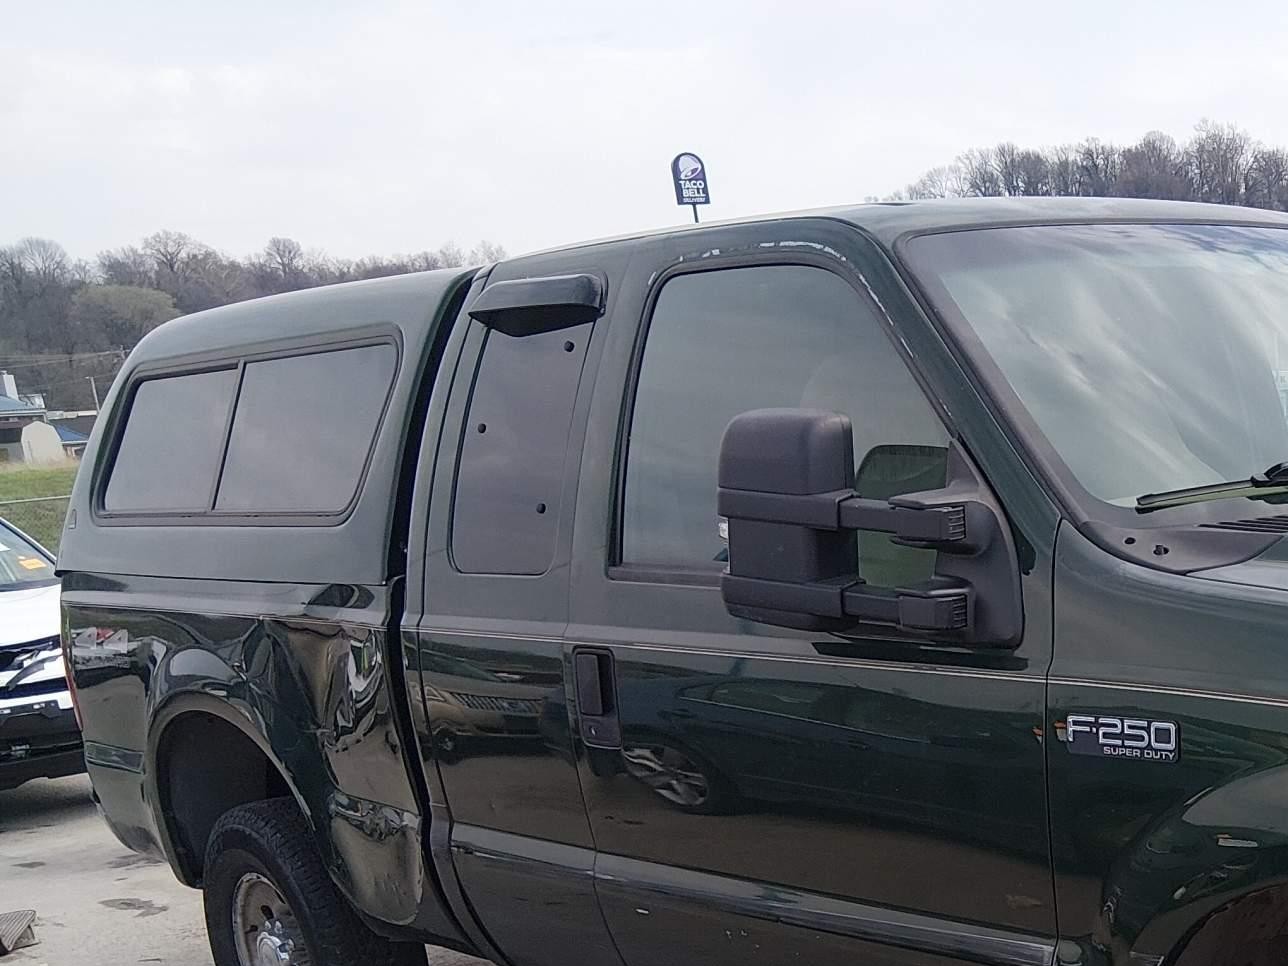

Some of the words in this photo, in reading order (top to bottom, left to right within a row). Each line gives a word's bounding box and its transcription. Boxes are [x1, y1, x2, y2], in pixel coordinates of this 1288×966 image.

[679, 180, 705, 189] TACO
[683, 189, 706, 198] BELL
[1103, 745, 1141, 758] SUPER
[1143, 749, 1176, 761] DUTY
